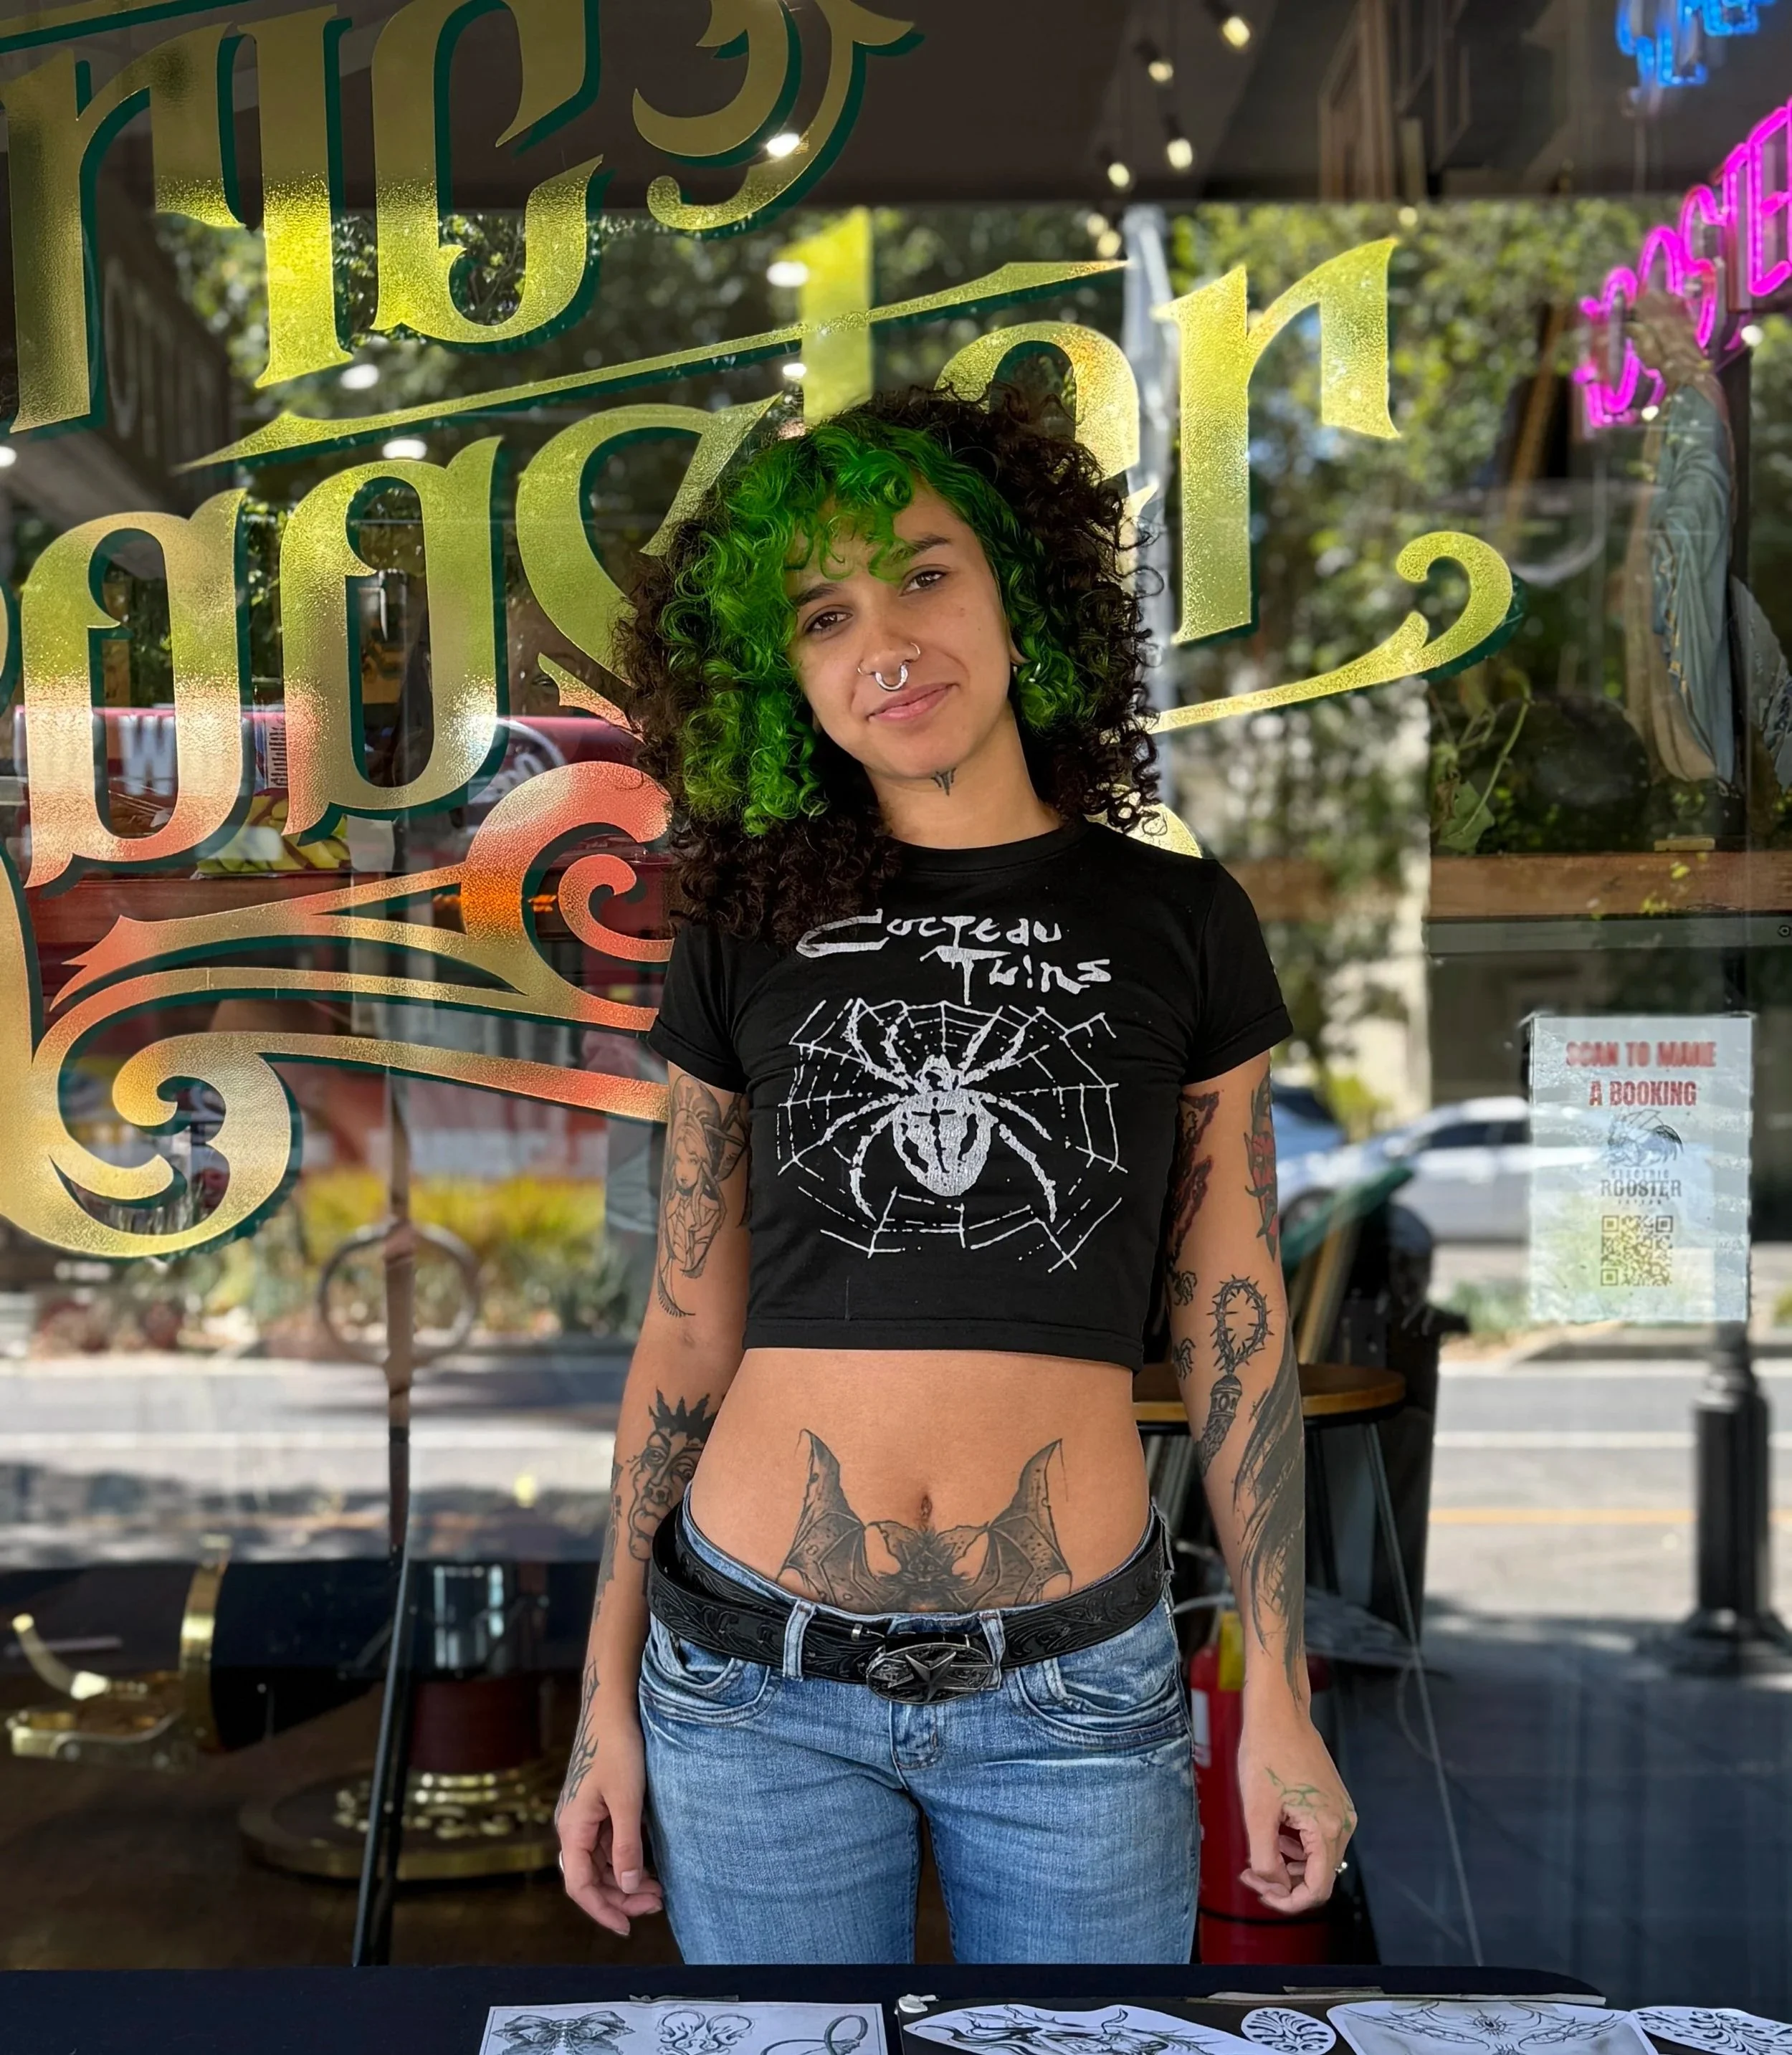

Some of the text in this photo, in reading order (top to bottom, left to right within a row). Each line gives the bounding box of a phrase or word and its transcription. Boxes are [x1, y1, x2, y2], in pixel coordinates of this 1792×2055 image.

[1626, 1041, 1650, 1067] TO
[1657, 1041, 1717, 1067] MAKE
[1588, 1080, 1697, 1106] A BOOKING
[1601, 1179, 1682, 1197] ROOSTER
